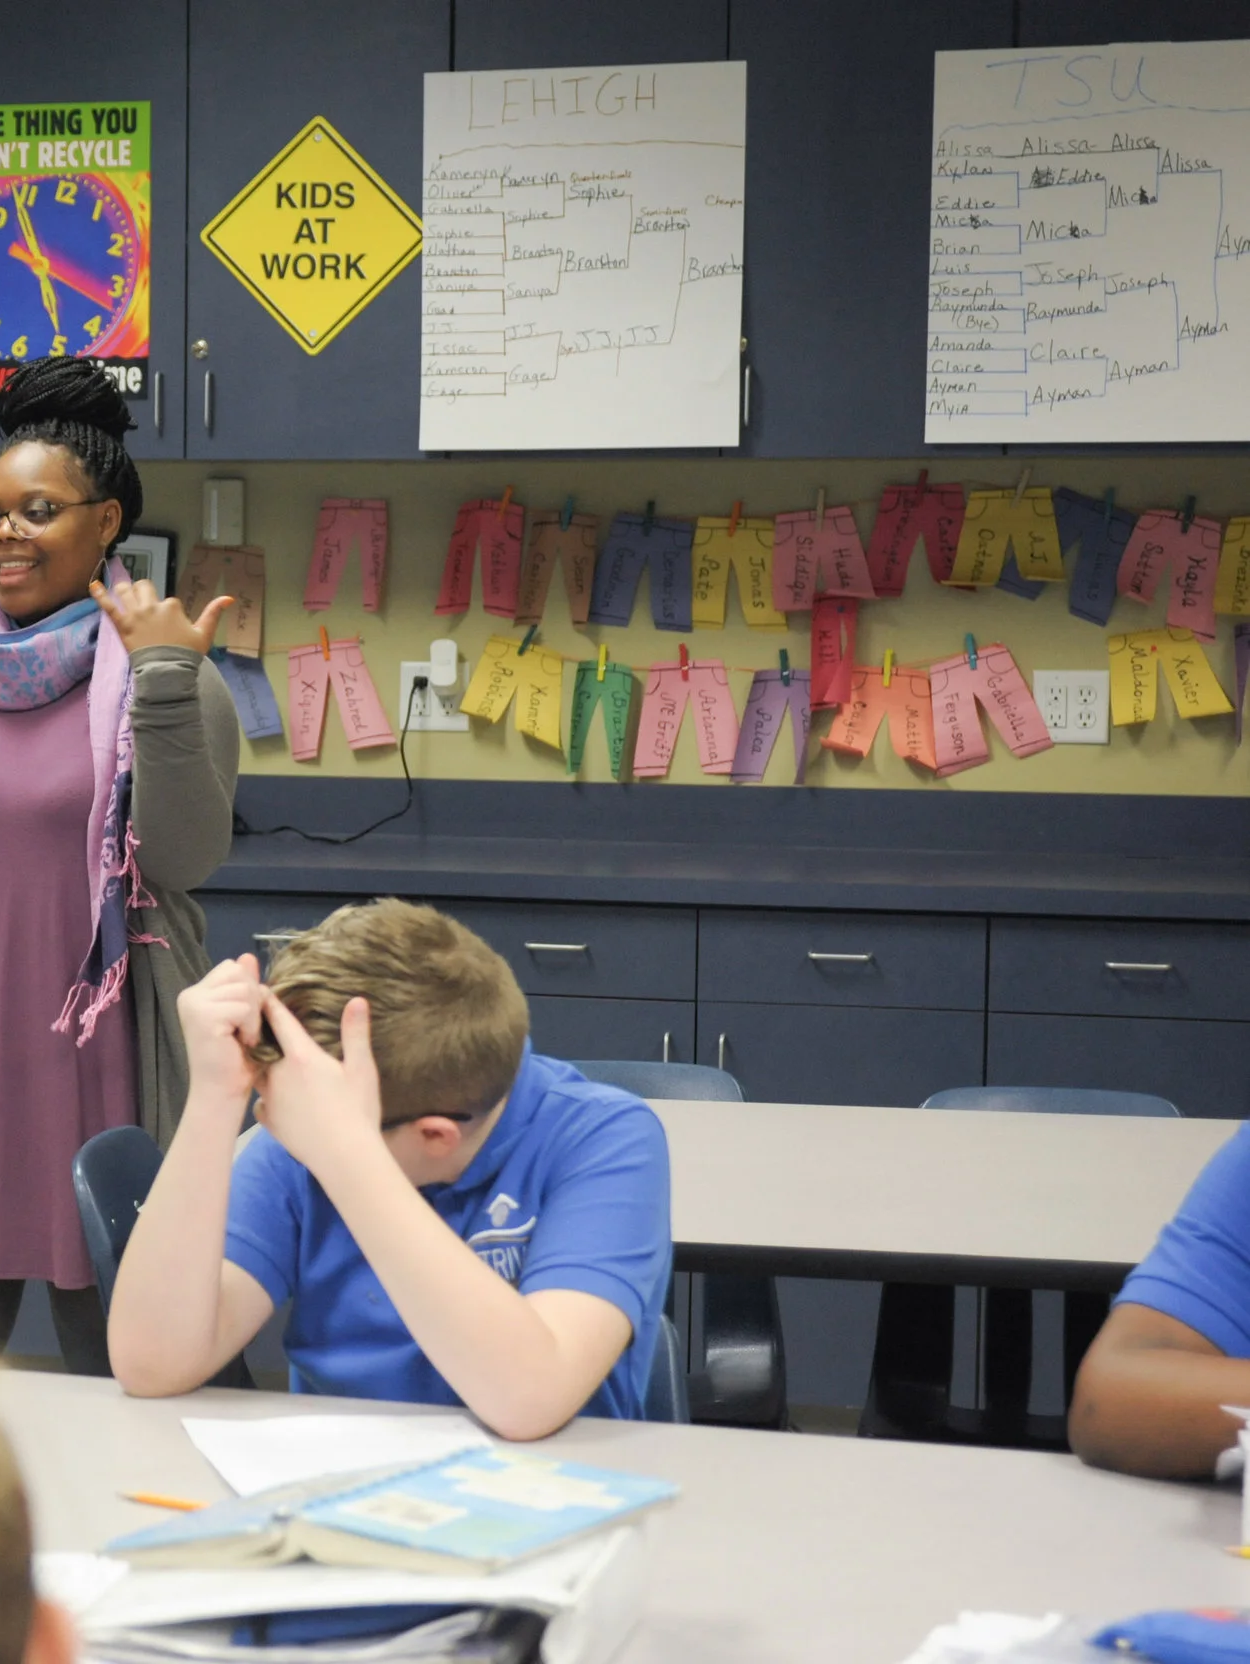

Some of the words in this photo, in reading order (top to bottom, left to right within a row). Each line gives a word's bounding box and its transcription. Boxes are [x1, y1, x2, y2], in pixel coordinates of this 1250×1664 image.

[987, 55, 1157, 107] TSU
[469, 72, 656, 130] LEHIGH
[13, 110, 83, 136] THING
[93, 108, 138, 135] YOU
[39, 140, 132, 168] RECYCLE
[935, 141, 993, 158] Alissa
[1161, 150, 1213, 174] Alissa
[55, 180, 78, 204] 12
[276, 181, 355, 209] KIDS
[935, 197, 996, 210] Eddie
[92, 200, 102, 222] 1
[293, 218, 336, 245] AT
[1218, 227, 1250, 254] Aym
[107, 234, 125, 257] 2
[933, 237, 980, 256] Brian
[261, 252, 367, 280] WORK
[932, 260, 971, 277] Luis
[1026, 261, 1098, 286] Joseph
[107, 275, 124, 298] 3
[929, 282, 994, 300] Joseph
[83, 315, 102, 338] 4
[1180, 316, 1229, 338] Ayman
[10, 336, 28, 358] 6
[49, 335, 67, 357] 5
[930, 337, 993, 352] Amanda
[1030, 338, 1106, 363] Claire
[508, 365, 550, 390] Gage
[932, 358, 985, 374] Claire
[1108, 359, 1169, 383] Ayman
[1032, 386, 1092, 410] Ayman
[694, 553, 721, 601] Pate
[748, 556, 766, 609] Jonas
[1176, 554, 1210, 609] Kayla
[1171, 654, 1200, 705] Xavier
[986, 675, 1028, 743] Gabriella
[697, 688, 720, 764] Arianna
[941, 691, 969, 757] Ferguson
